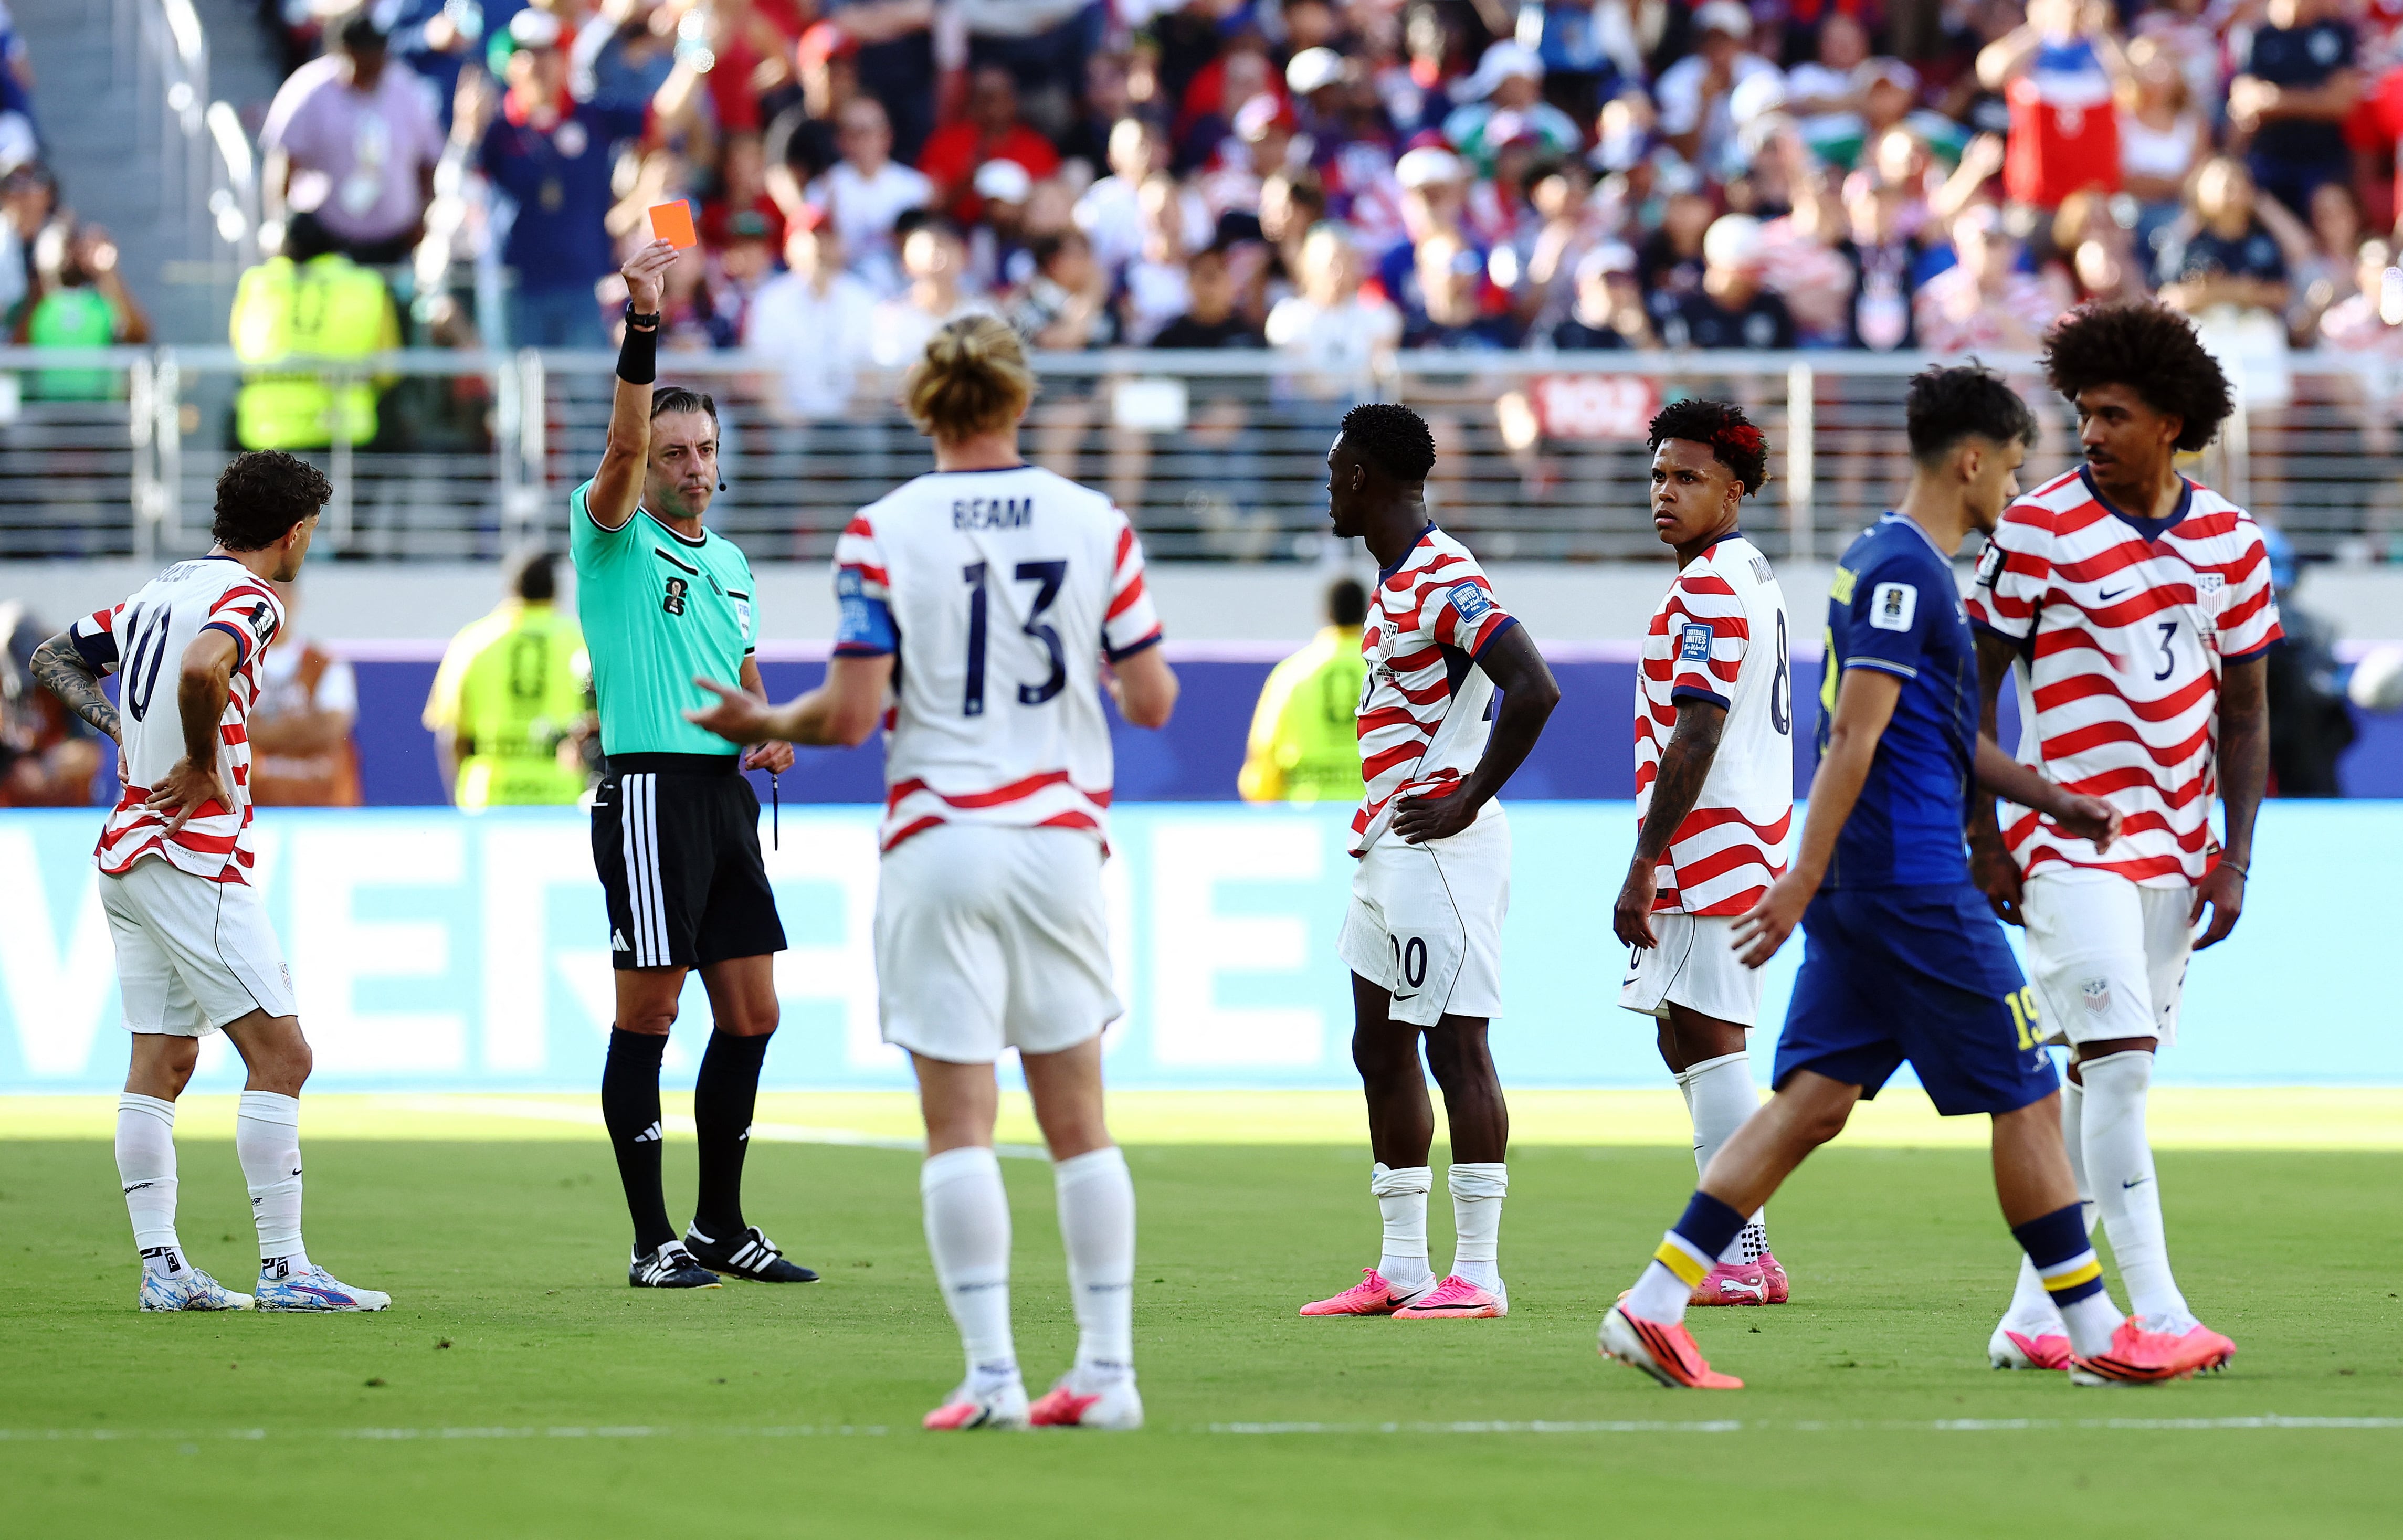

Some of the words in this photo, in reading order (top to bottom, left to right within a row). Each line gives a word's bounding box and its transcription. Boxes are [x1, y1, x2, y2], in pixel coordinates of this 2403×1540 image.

[953, 498, 1032, 528] BEAM
[1453, 586, 1475, 598] FOOTBALL
[1457, 589, 1477, 605] UNITES
[964, 560, 1068, 716] 13
[1383, 622, 1397, 639] USA
[1685, 636, 1707, 645] UNITES
[1691, 644, 1707, 652] World
[2154, 622, 2178, 681] 3
[119, 600, 172, 723] 10
[1771, 608, 1790, 735] 8
[168, 844, 196, 859] AERO-FIT
